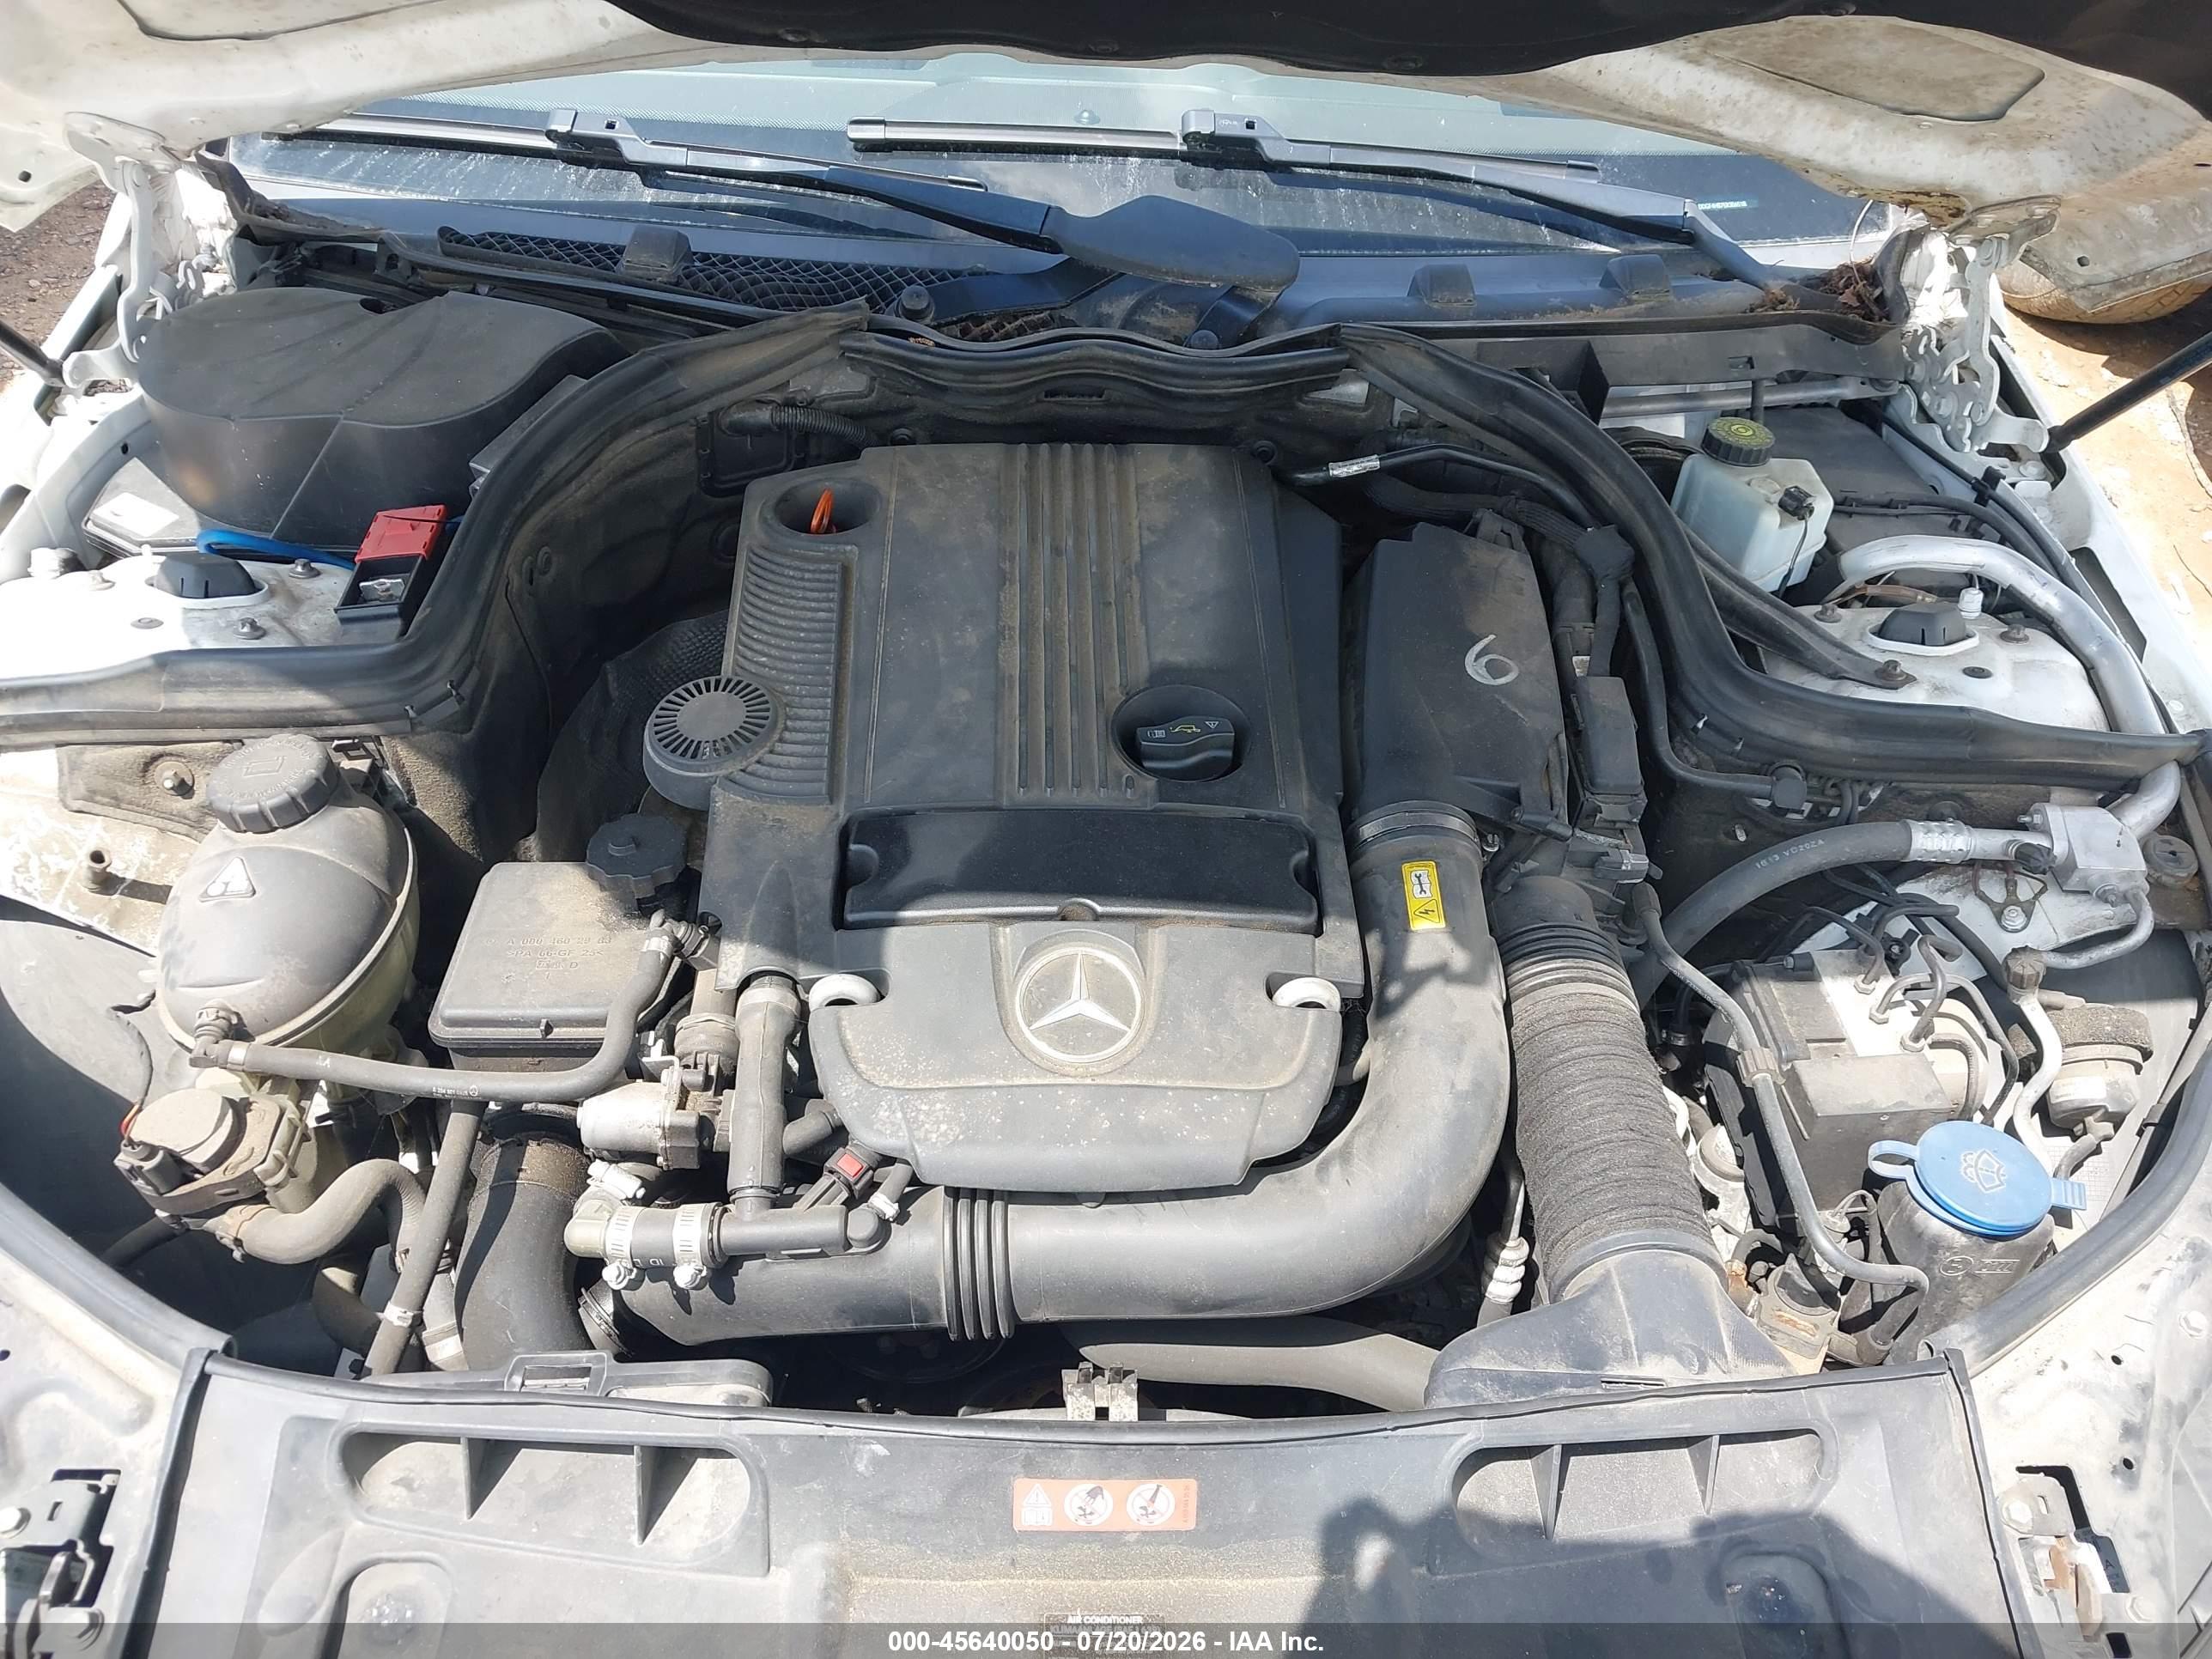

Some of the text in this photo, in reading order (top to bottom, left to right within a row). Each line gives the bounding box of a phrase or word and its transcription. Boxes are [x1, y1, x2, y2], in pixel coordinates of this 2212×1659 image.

[1464, 634, 1519, 686] 6
[1067, 1615, 1144, 1624] AIR CONDITIONER
